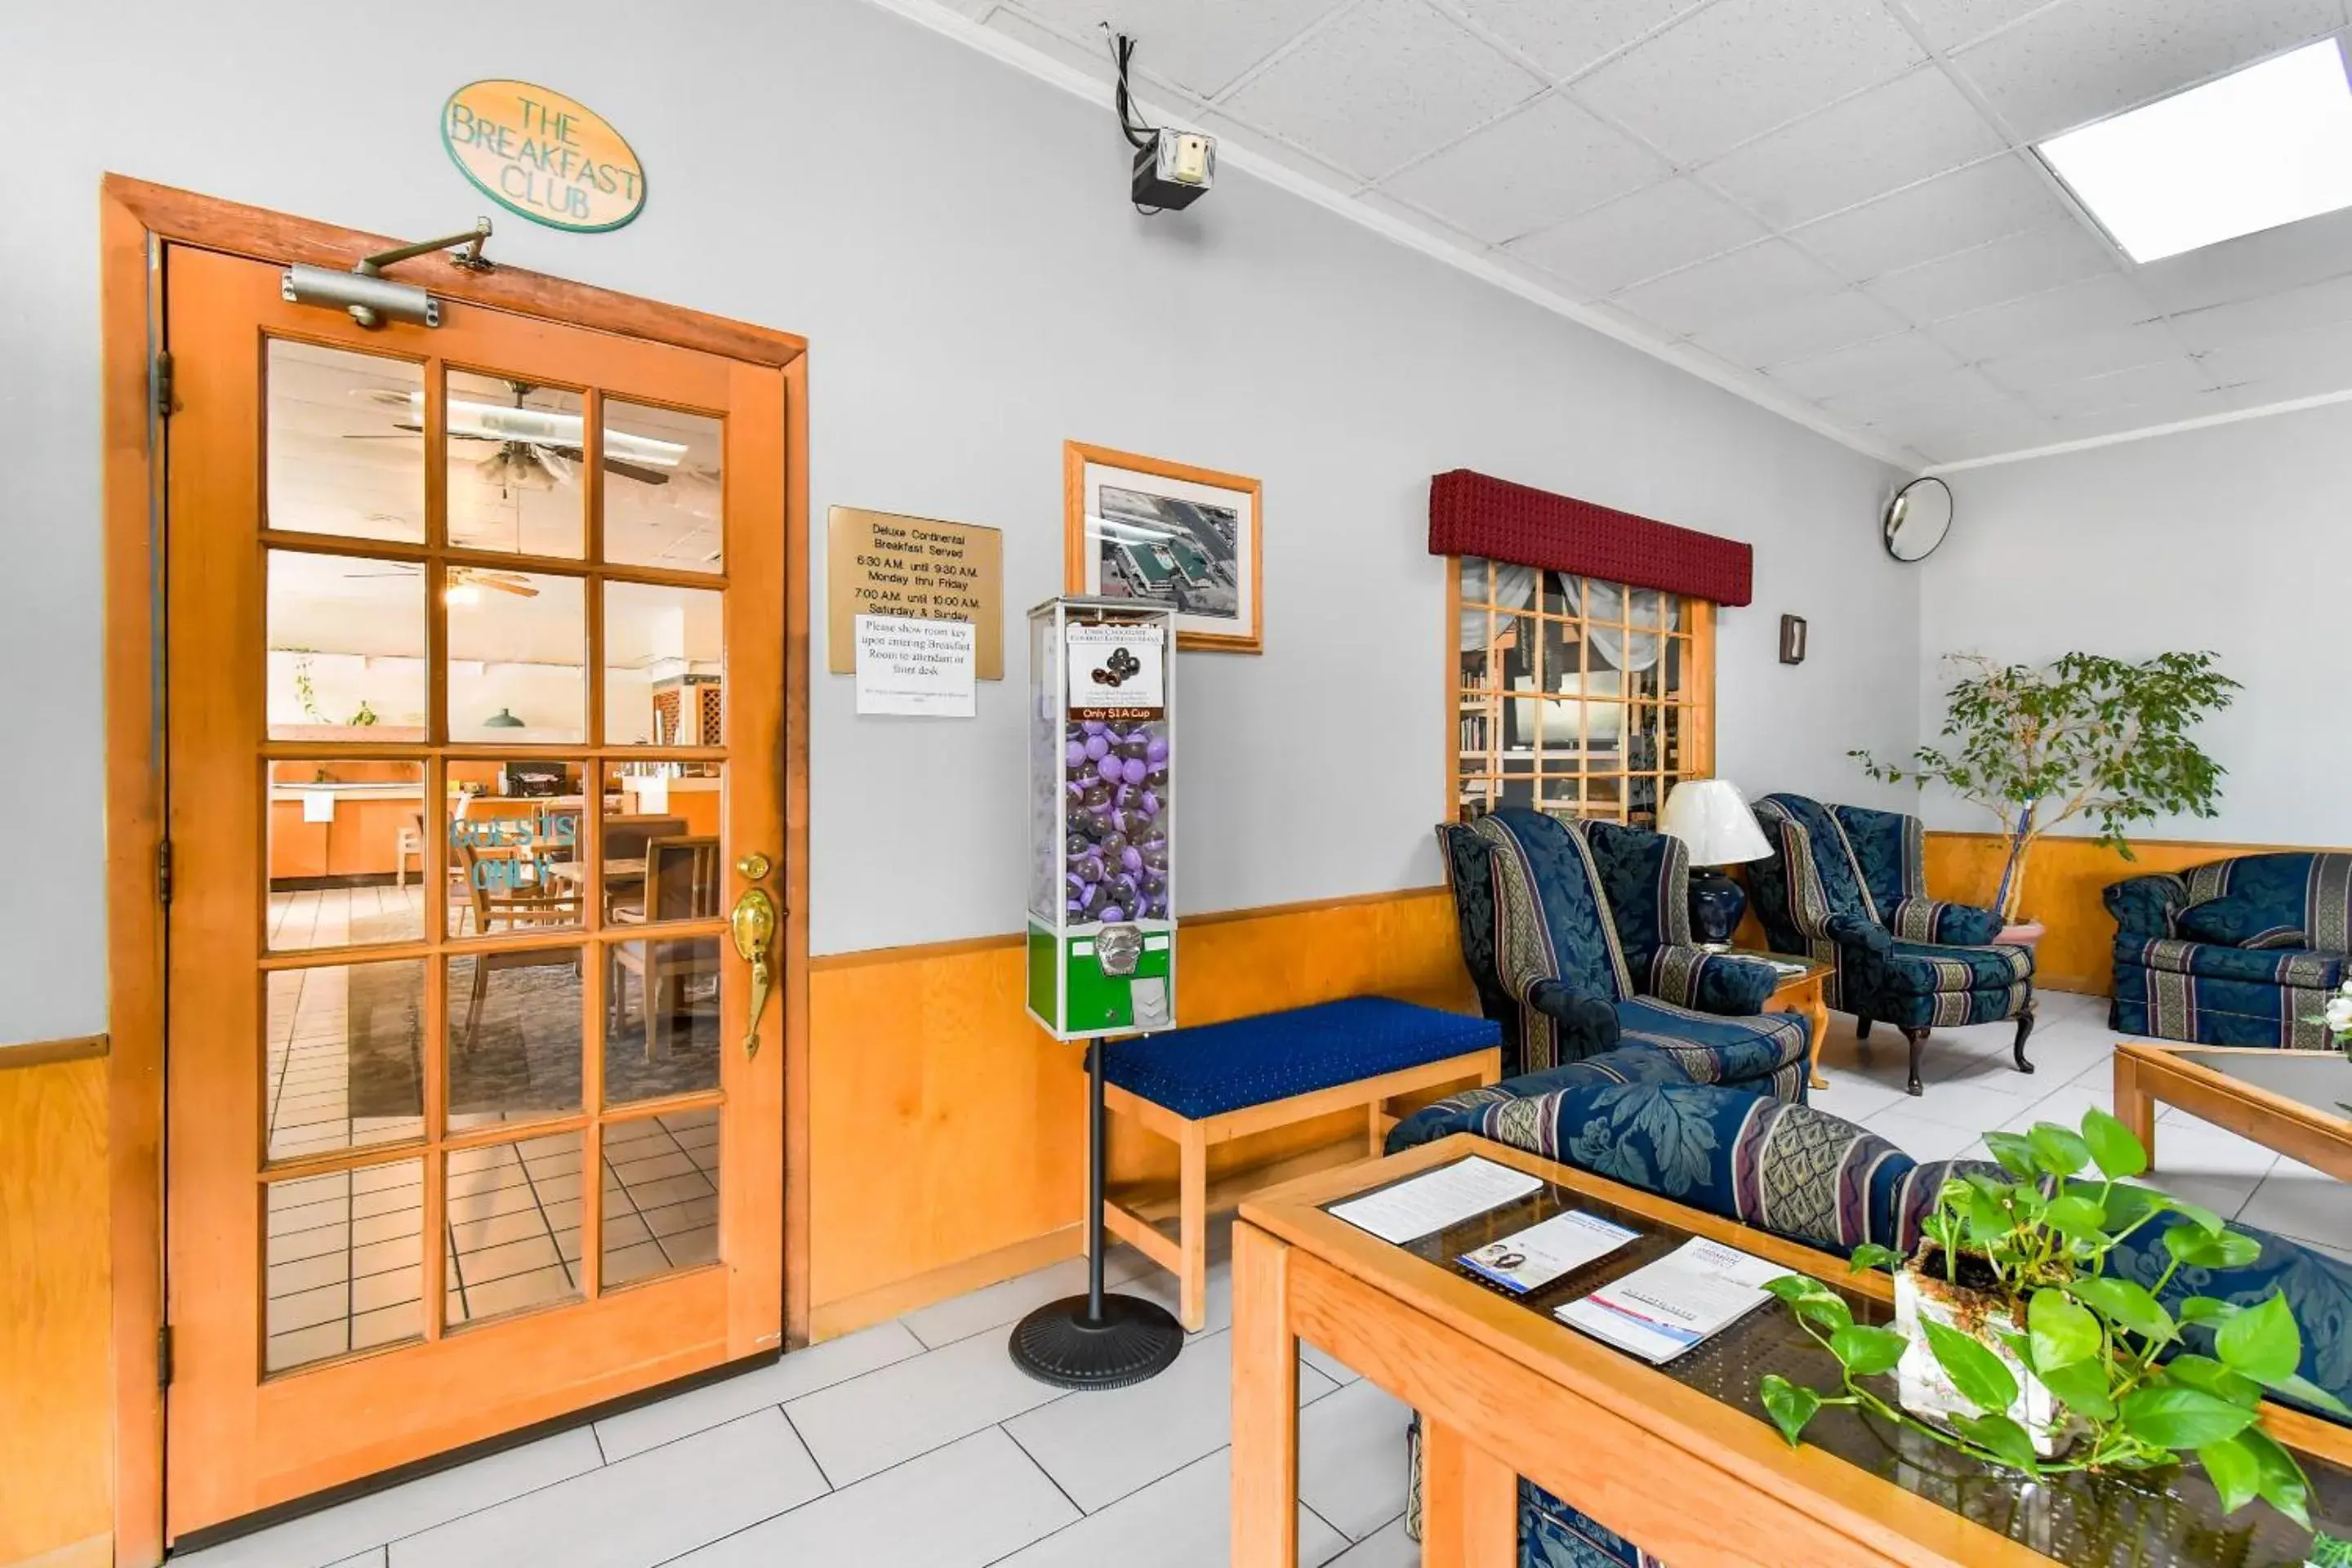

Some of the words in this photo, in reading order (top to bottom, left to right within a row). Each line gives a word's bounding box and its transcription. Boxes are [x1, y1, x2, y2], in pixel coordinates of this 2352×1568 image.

[517, 96, 580, 148] THE
[452, 102, 641, 201] BREAKFAST
[500, 163, 590, 220] CLUB
[872, 523, 906, 537] Deluxe
[912, 529, 965, 546] Continental
[875, 539, 923, 554] Breakfast
[929, 546, 964, 559] Served
[858, 555, 880, 568] 6:30
[911, 563, 929, 572] until
[933, 564, 957, 576] 9:30
[868, 571, 908, 586] Monday
[915, 577, 933, 586] thru
[939, 578, 969, 592] Friday
[854, 588, 879, 599] 7:00
[907, 595, 927, 604] until
[933, 595, 958, 606] 10:00
[869, 604, 915, 618] Saturday
[920, 608, 928, 617] &
[934, 609, 969, 622] Sunday
[866, 620, 896, 632] Please
[898, 624, 922, 634] show
[862, 637, 885, 647] upon
[869, 648, 898, 659] Room
[1083, 708, 1106, 719] Only
[1121, 709, 1129, 718] A
[1130, 708, 1150, 719] Cup
[451, 816, 576, 849] GUESTS
[472, 856, 553, 892] ONLY
